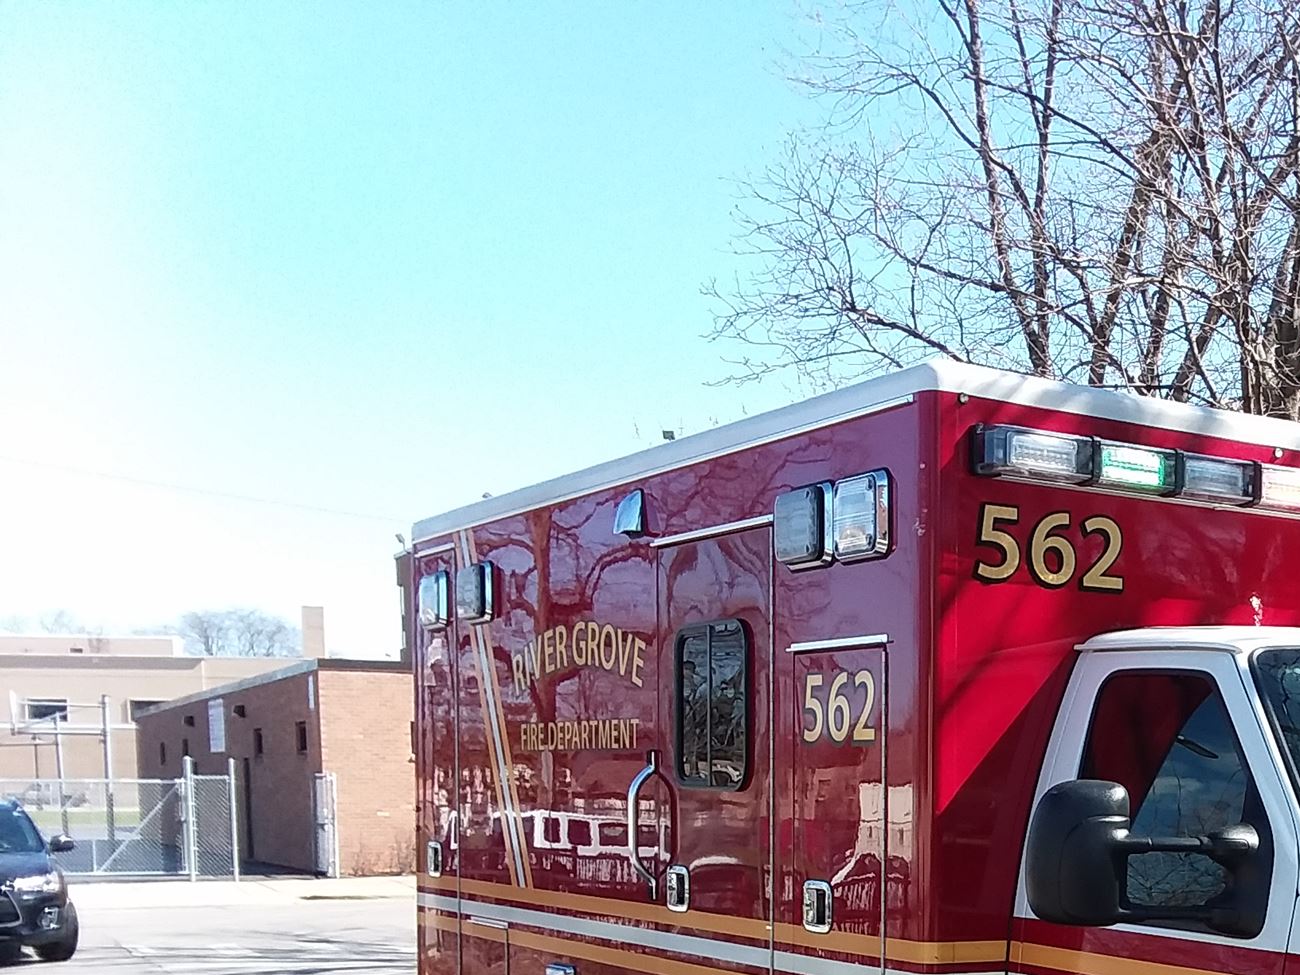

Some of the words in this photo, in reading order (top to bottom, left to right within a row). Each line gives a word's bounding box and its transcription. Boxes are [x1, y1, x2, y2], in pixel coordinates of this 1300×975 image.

[974, 502, 1124, 592] 562
[512, 624, 569, 697] RIVER
[572, 621, 646, 688] GROVE
[520, 722, 545, 751] FIRE
[547, 718, 640, 750] DEPARTMENT
[803, 669, 876, 743] 562
